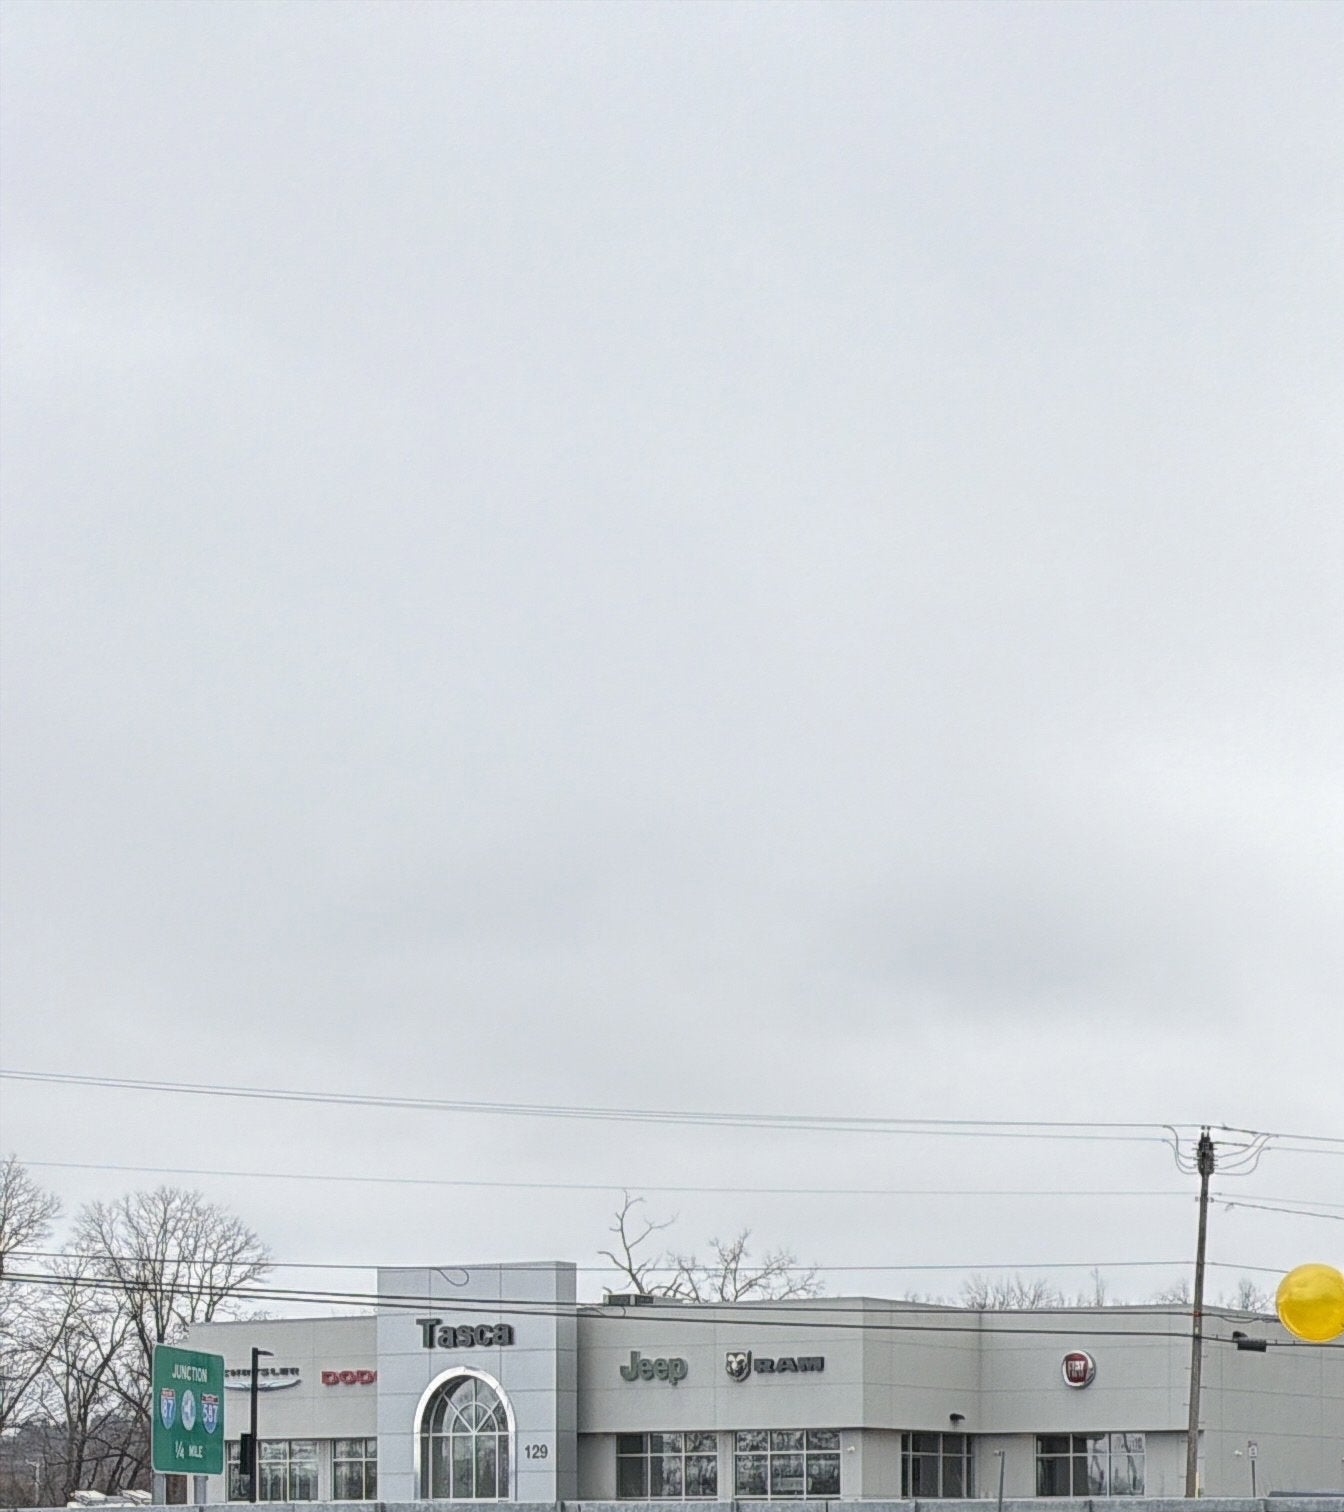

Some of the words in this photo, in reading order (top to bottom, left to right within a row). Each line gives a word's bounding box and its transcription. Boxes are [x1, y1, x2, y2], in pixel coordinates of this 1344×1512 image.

[416, 1318, 514, 1349] Tasca
[172, 1363, 208, 1383] JUNCTION
[619, 1350, 689, 1386] Jeep
[754, 1356, 825, 1374] RAM
[321, 1370, 378, 1386] DOD
[188, 1444, 203, 1459] MILE
[524, 1444, 548, 1459] 129
